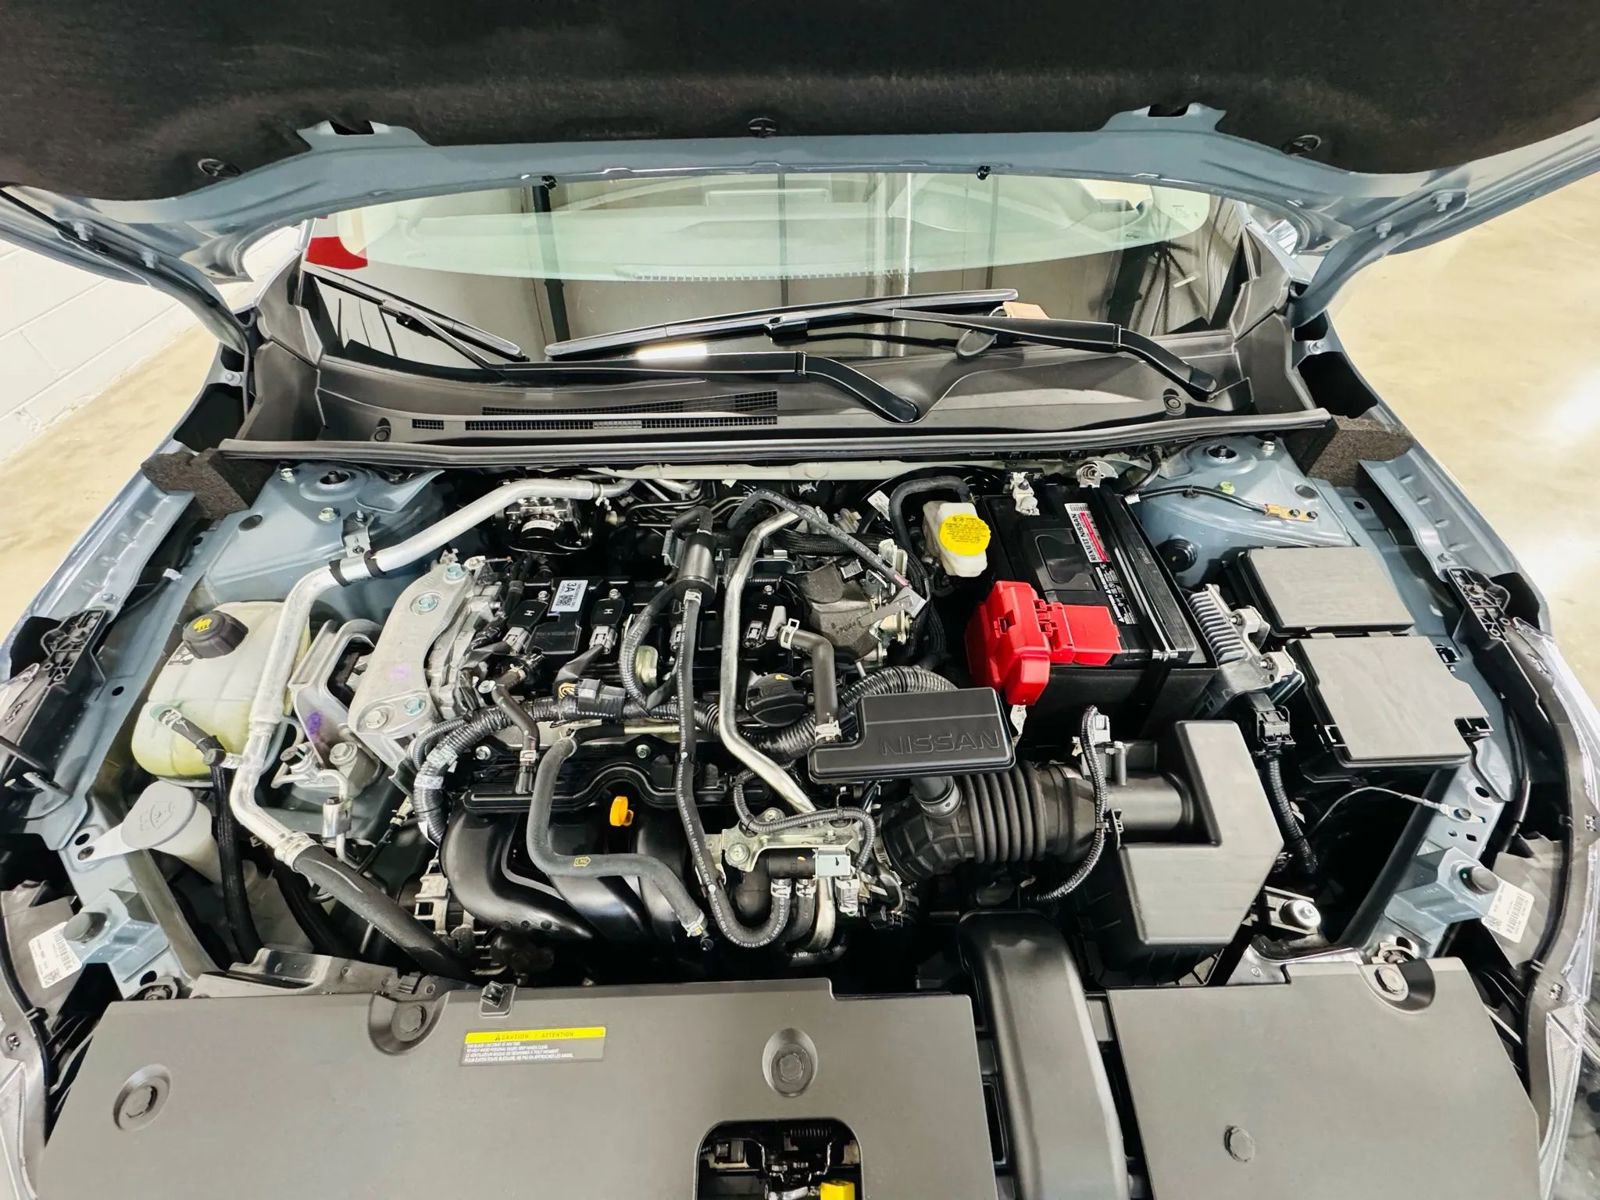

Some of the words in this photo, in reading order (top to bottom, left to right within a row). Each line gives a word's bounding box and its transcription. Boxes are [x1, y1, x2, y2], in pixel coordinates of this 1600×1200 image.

[1071, 513, 1086, 538] NISSAN
[565, 583, 577, 593] 3A
[881, 729, 1001, 756] NISSAN
